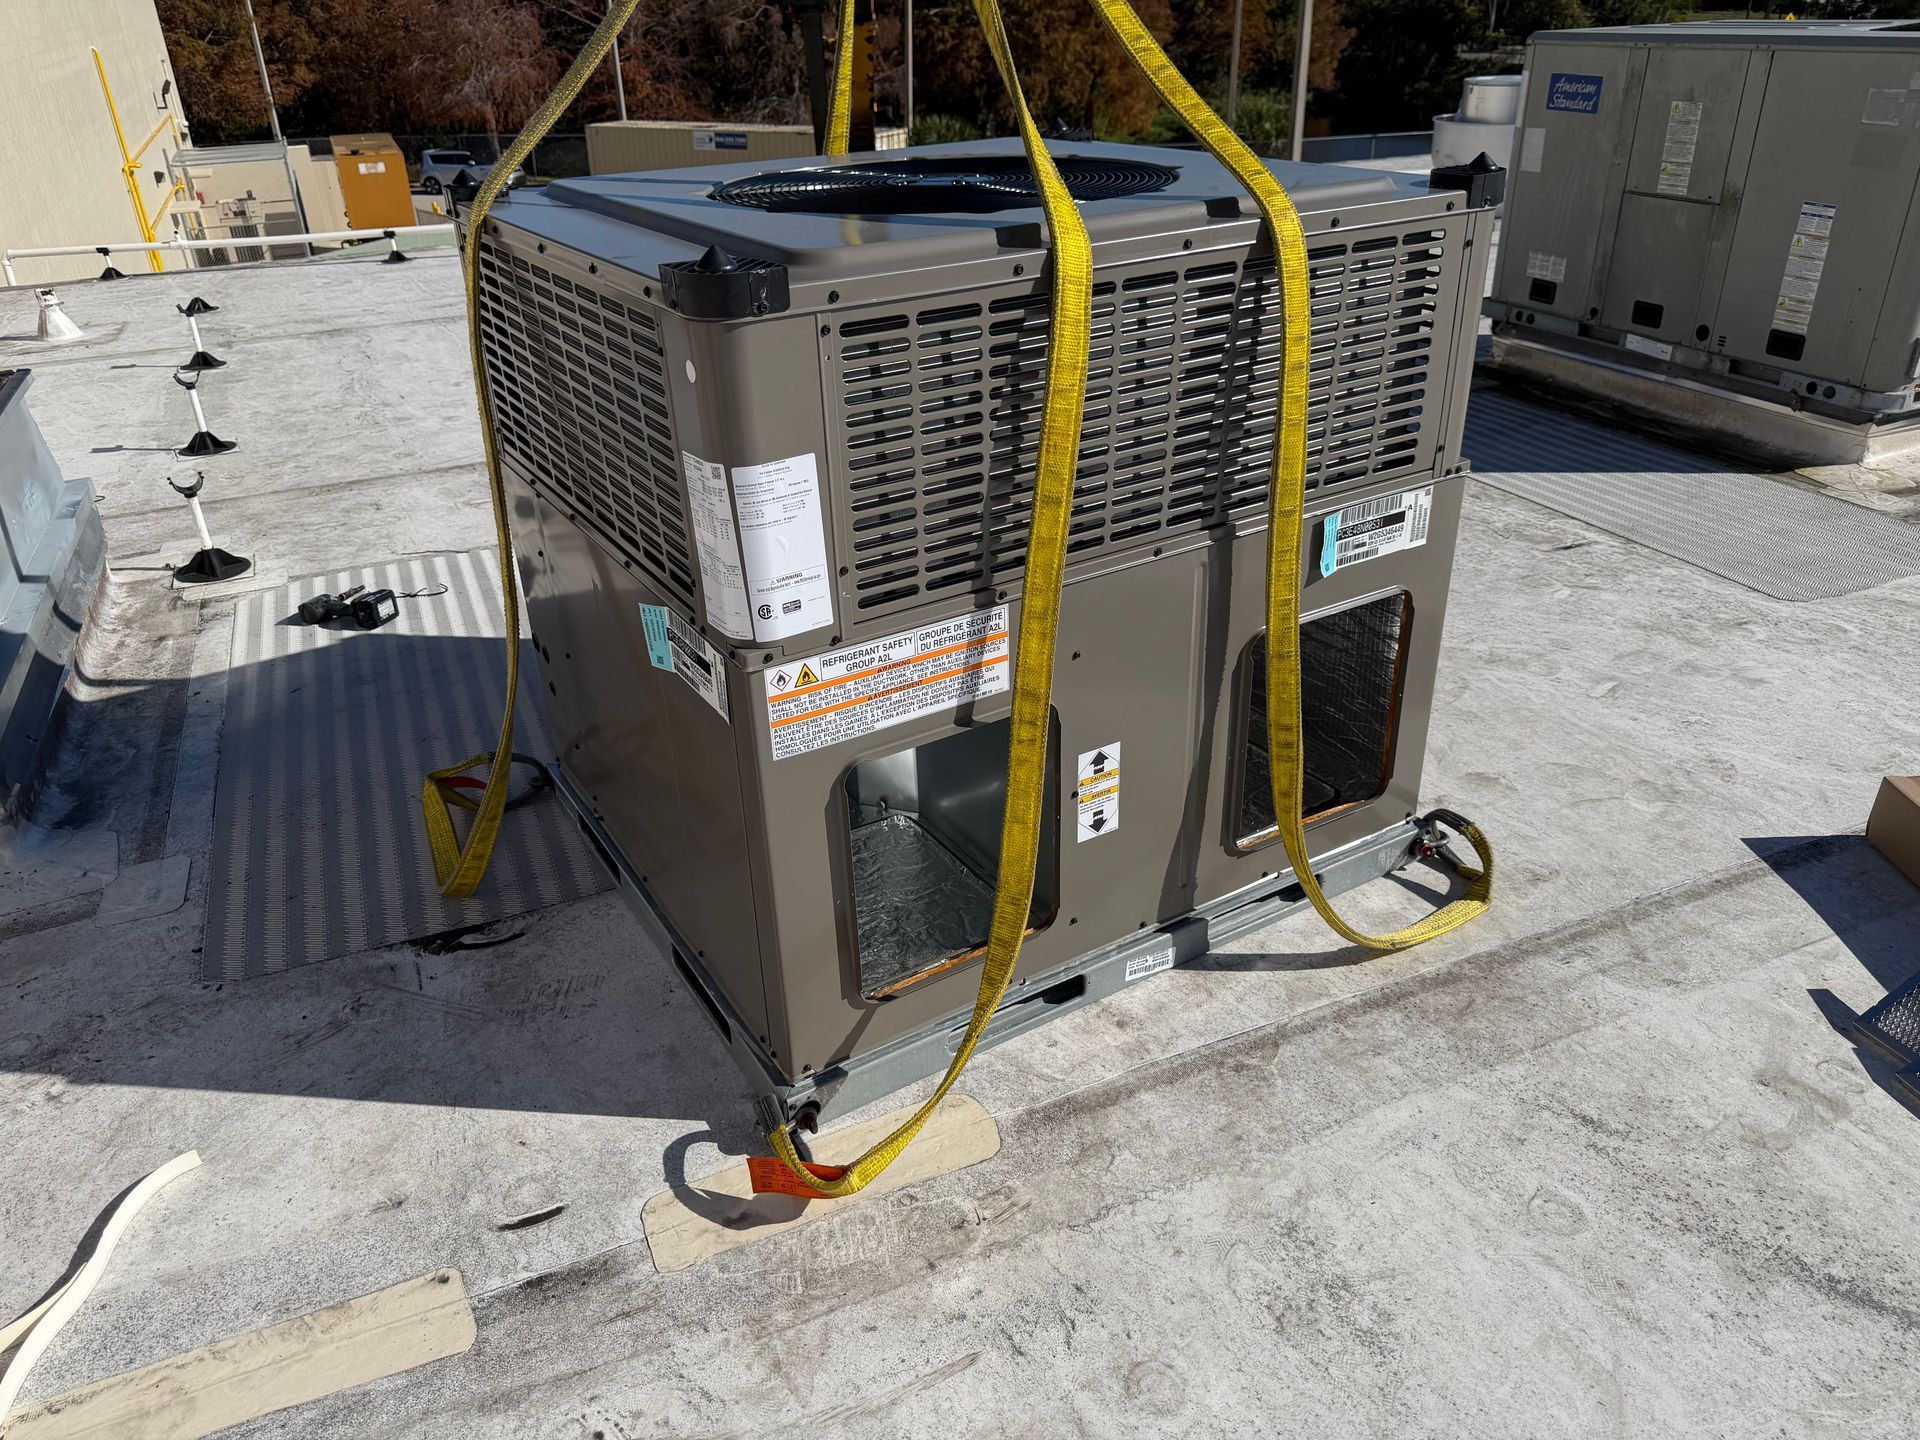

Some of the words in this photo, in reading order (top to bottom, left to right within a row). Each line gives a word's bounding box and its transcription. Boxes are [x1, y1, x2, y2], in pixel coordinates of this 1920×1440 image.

[1553, 76, 1598, 95] American
[1548, 94, 1598, 111] Standard
[776, 571, 803, 584] WARNING
[918, 625, 951, 641] GROUPE
[953, 622, 963, 632] DE
[965, 609, 1002, 628] SÉCURITÉ
[920, 640, 931, 651] DU
[933, 625, 986, 647] RÉFRIGÉRANT
[988, 621, 1002, 632] A2L
[822, 644, 880, 668] REFRIGERANT
[882, 635, 912, 651] SAFETY
[845, 656, 875, 672] GROUP
[877, 651, 892, 663] A2L
[881, 658, 910, 672] WARNING
[770, 695, 801, 709] WARNING
[807, 689, 822, 698] RISK
[833, 682, 847, 691] FIRE
[853, 672, 884, 685] AUXILIARY
[885, 665, 910, 676] DEVICES
[911, 659, 930, 669] WHICH
[932, 655, 943, 663] MAY
[771, 704, 792, 715] SHALL
[793, 700, 806, 709] NOT
[818, 687, 851, 701] INSTALLED
[860, 681, 871, 690] THE
[909, 665, 929, 675] OTHER
[931, 661, 945, 669] THAN
[947, 652, 975, 665] AUXILIARY
[977, 645, 1000, 656] DEVICES
[874, 679, 922, 698] AVERTISSEMENT
[771, 710, 794, 721] LISTED
[795, 706, 808, 714] FOR
[810, 702, 822, 710] USE
[824, 697, 839, 706] WITH
[841, 693, 852, 701] THE
[854, 685, 880, 697] SPECIFIC
[917, 671, 927, 679] SEE
[773, 714, 827, 735] AVERTISSEMENT
[834, 705, 857, 717] RISQUE
[899, 690, 910, 698] LES
[773, 727, 804, 741] PEUVENT
[824, 717, 837, 726] DES
[838, 708, 868, 721] SOURCES
[811, 725, 829, 735] DANS
[831, 721, 843, 730] LES
[916, 696, 927, 704] DES
[823, 728, 841, 738] POUR
[842, 724, 855, 732] UNE
[857, 712, 893, 728] UTILISATION
[895, 707, 911, 716] AVEC
[775, 742, 815, 758] CONSULTEZ
[816, 738, 828, 746] LES
